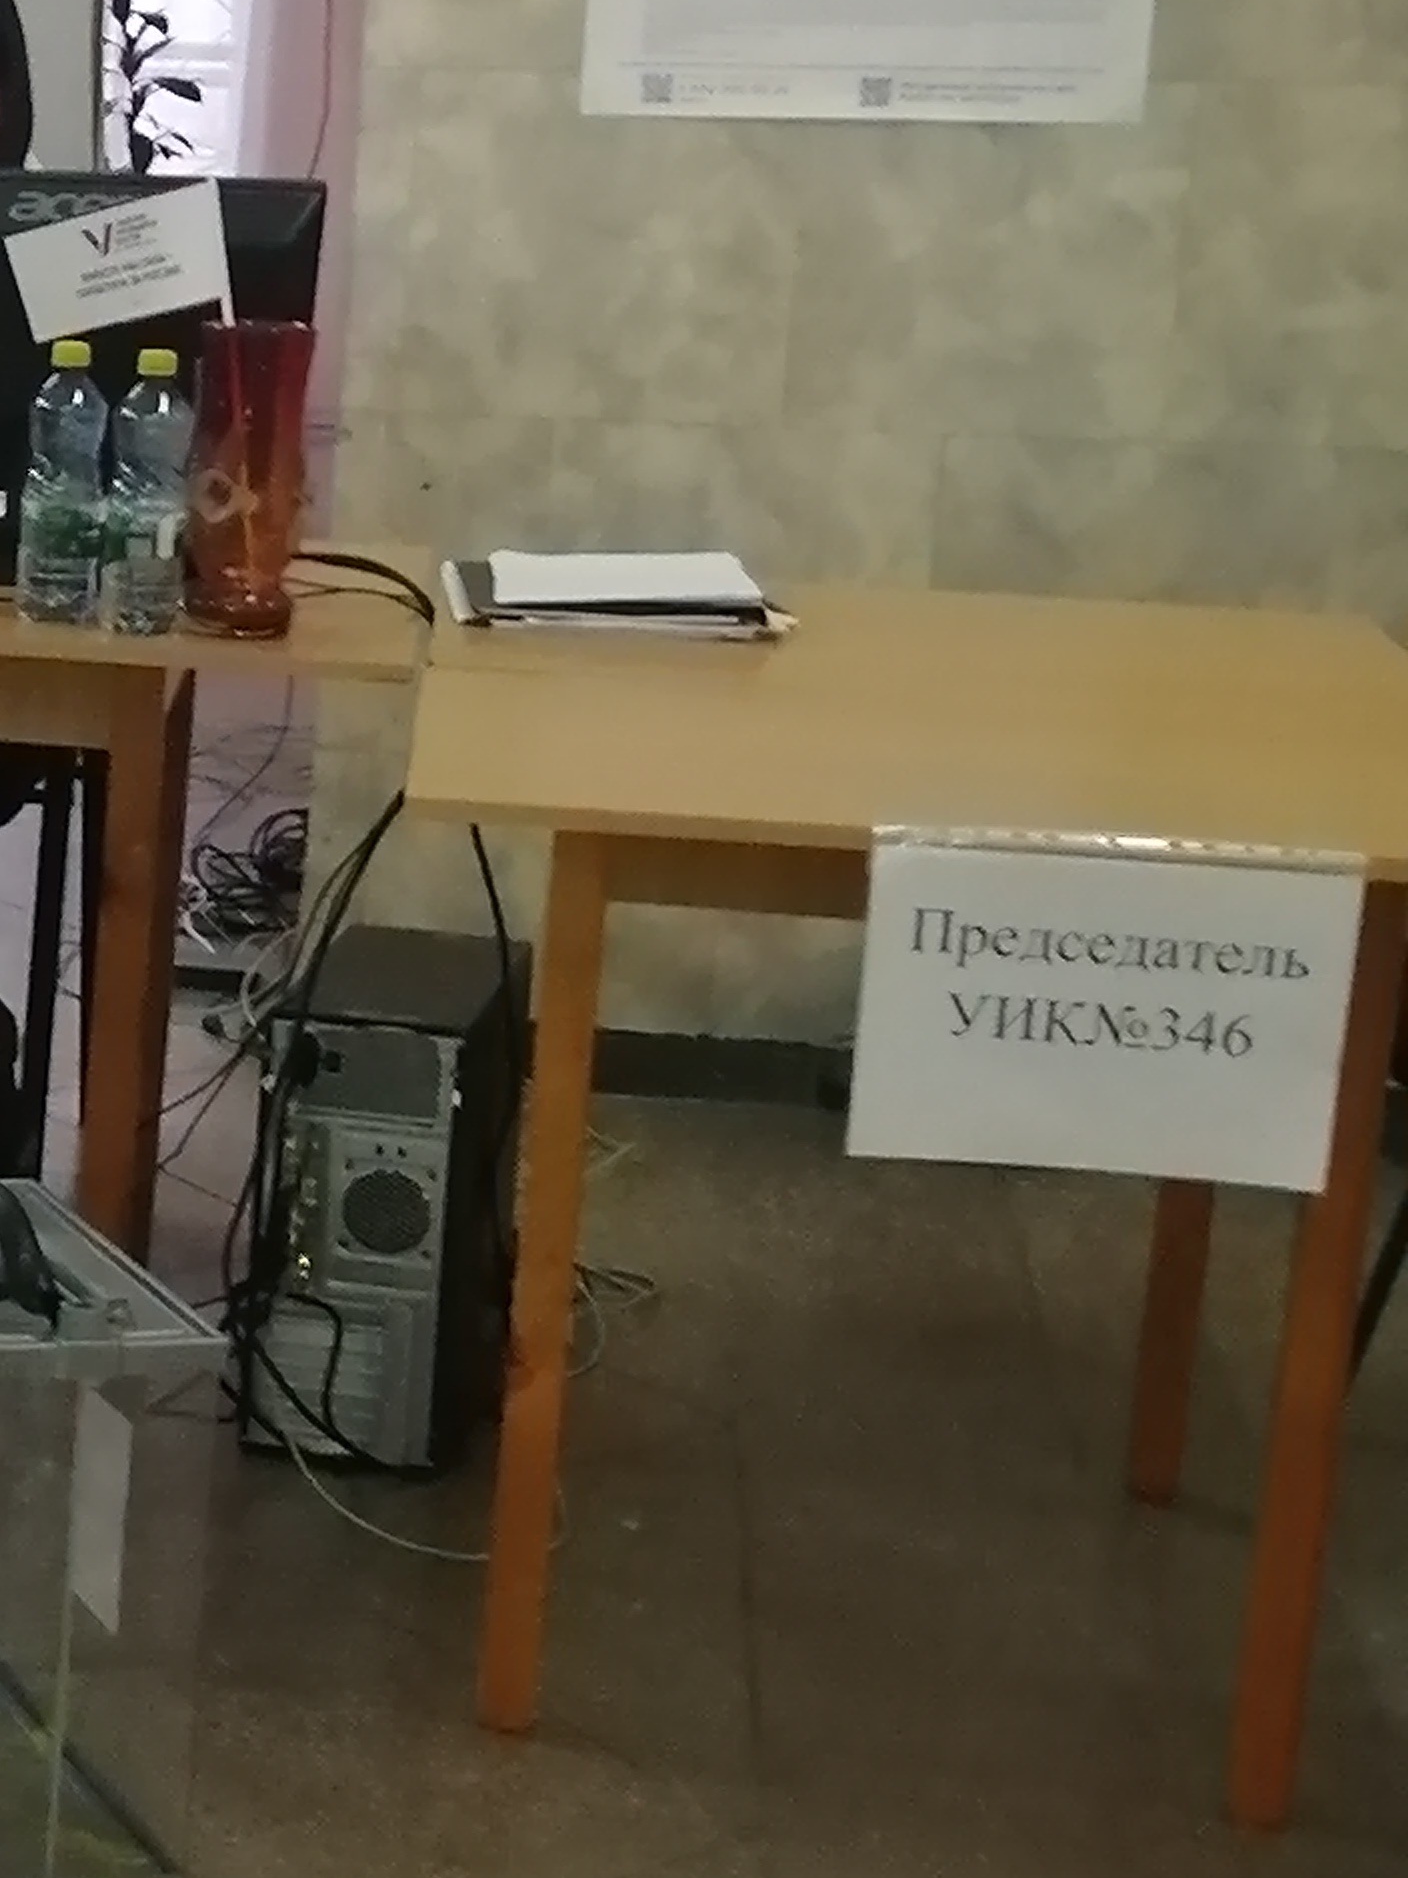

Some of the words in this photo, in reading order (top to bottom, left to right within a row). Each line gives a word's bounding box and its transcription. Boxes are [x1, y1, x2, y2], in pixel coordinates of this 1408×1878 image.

[7, 190, 135, 223] ace
[909, 906, 1312, 980] Председатель
[948, 990, 1255, 1058] УИК№346
